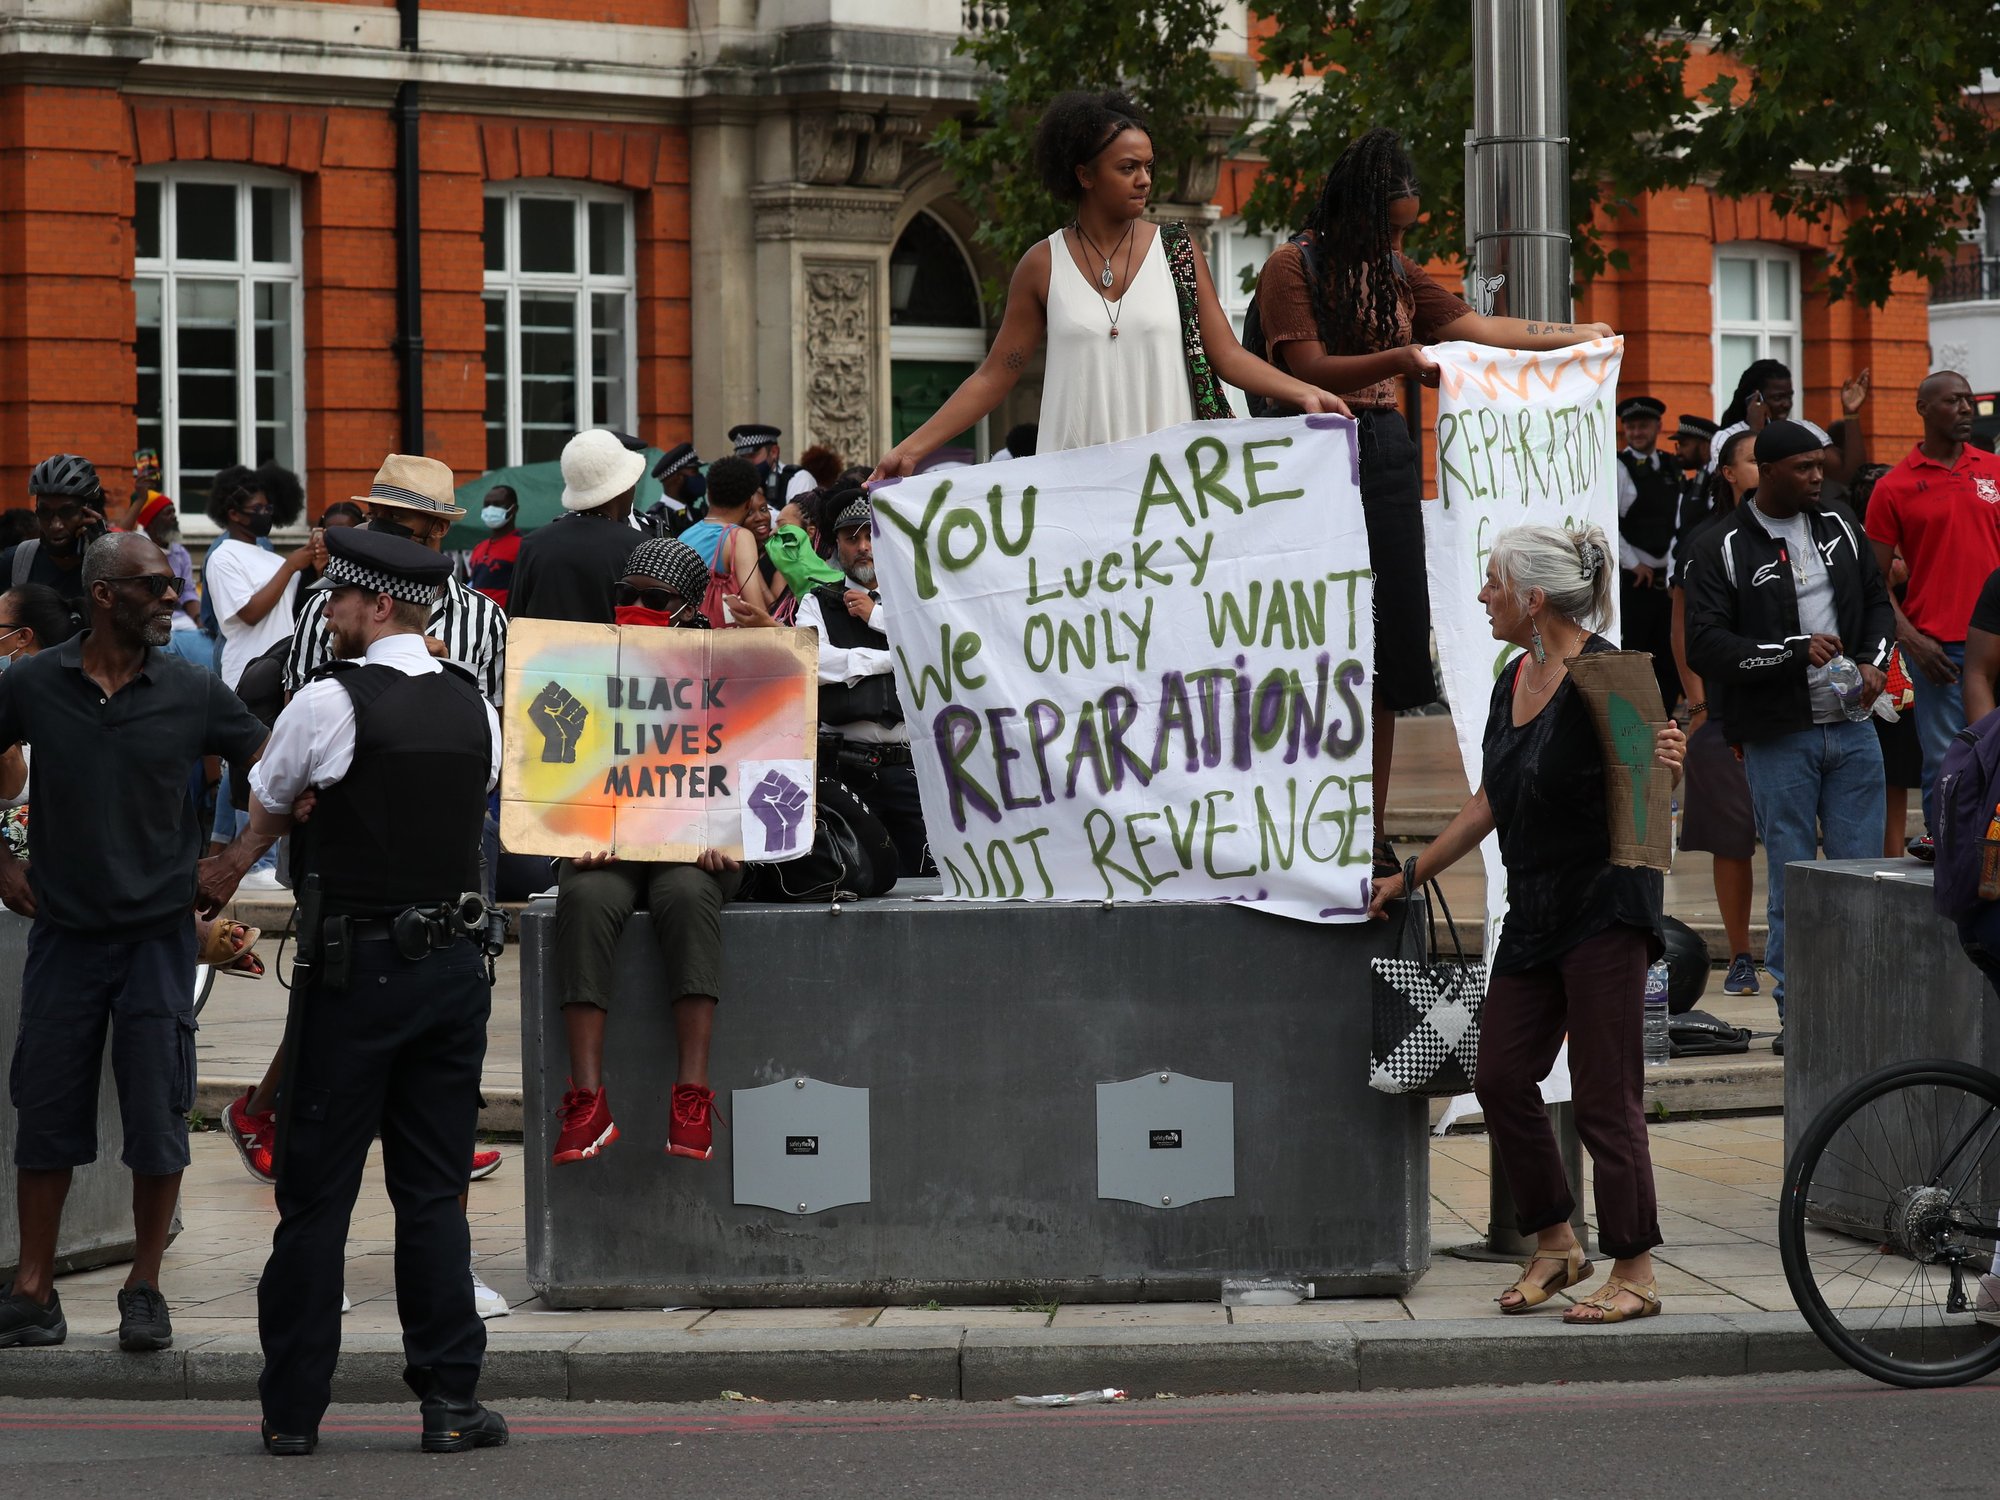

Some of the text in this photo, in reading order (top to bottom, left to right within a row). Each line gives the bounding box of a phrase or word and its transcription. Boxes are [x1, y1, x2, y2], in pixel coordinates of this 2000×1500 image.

[872, 436, 1306, 600] YOU ARE
[1026, 531, 1215, 606] LUCKY
[897, 568, 1372, 711] We ONLY WANT
[607, 675, 728, 711] BLACK
[613, 722, 724, 756] LIVES
[603, 763, 732, 799] MATTER
[943, 774, 1373, 899] NOT REVENGE
